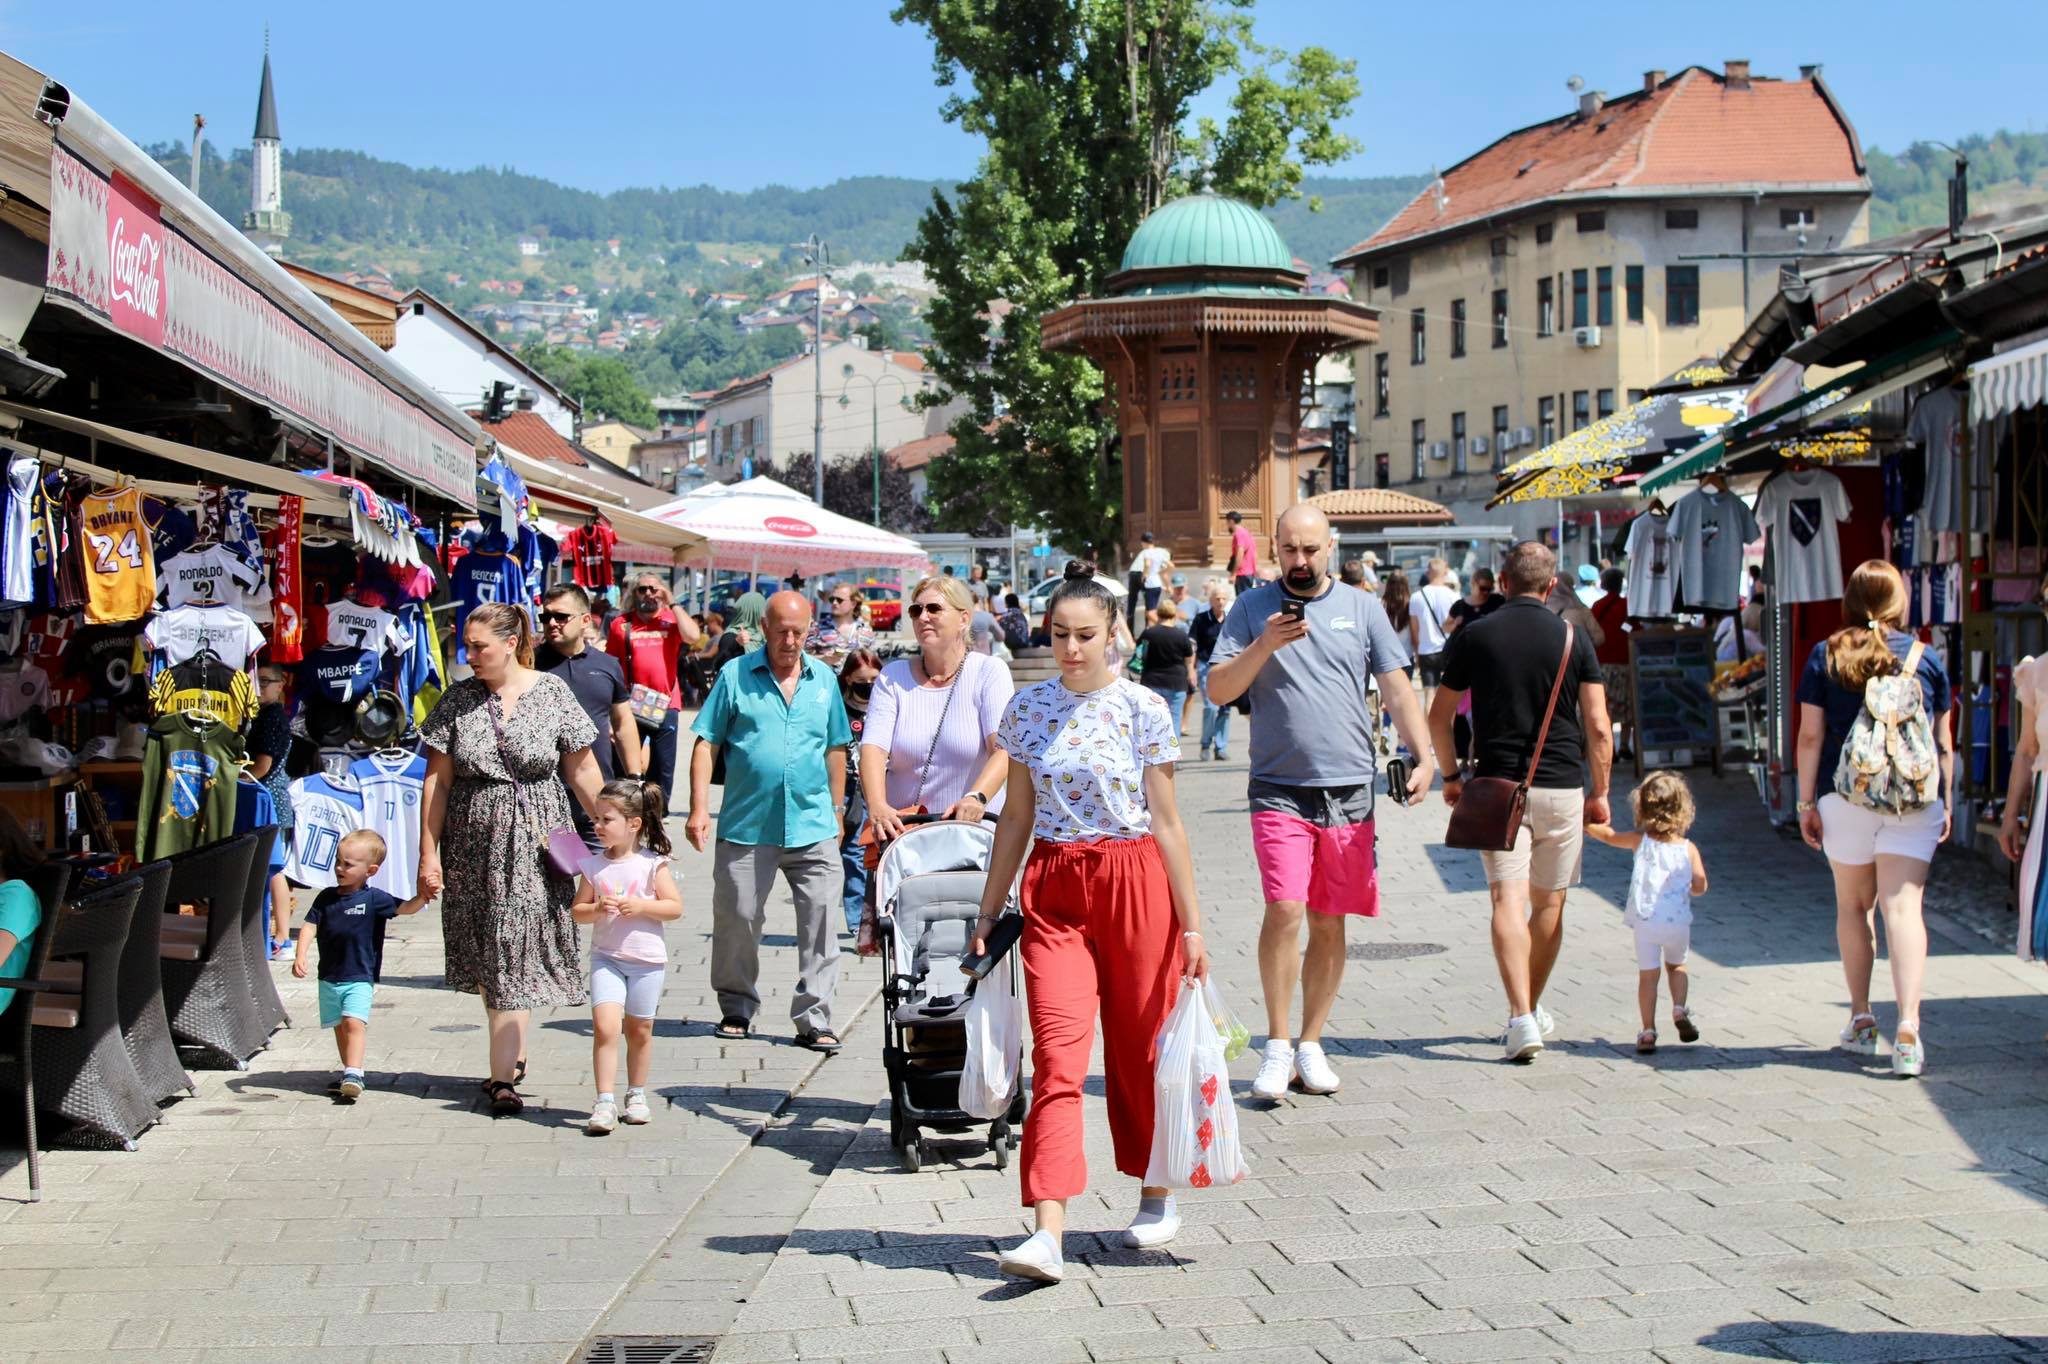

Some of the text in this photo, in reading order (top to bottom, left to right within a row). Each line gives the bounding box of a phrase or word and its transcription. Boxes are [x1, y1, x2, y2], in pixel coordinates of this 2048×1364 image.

[111, 216, 160, 320] Coca-Cola
[1335, 430, 1346, 487] HOTEL
[90, 510, 134, 531] BRYANT
[88, 528, 143, 574] 24
[179, 565, 223, 581] RONALDO
[338, 614, 377, 629] RONALDO
[347, 627, 367, 648] 7
[106, 657, 132, 696] 9
[317, 661, 363, 680] MBAPPÉ
[330, 679, 353, 703] 7
[384, 800, 396, 821] 17
[300, 823, 341, 872] 10
